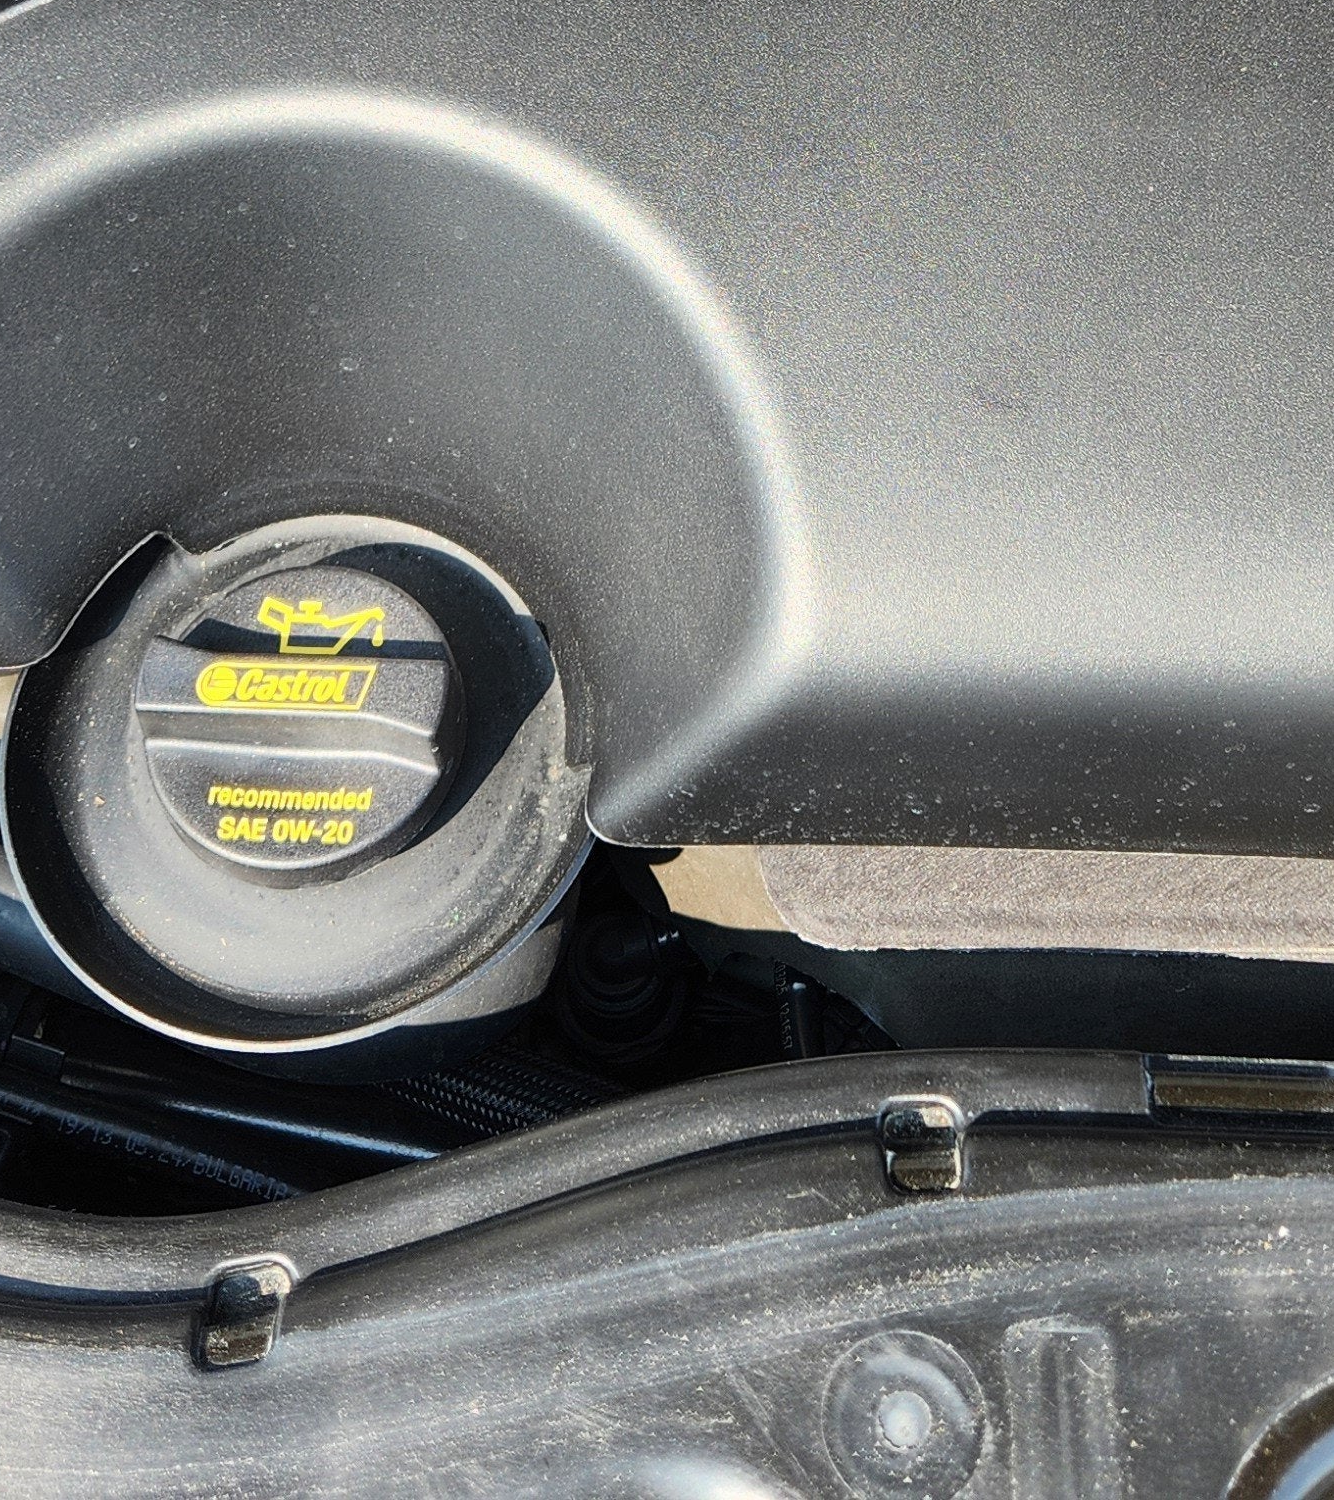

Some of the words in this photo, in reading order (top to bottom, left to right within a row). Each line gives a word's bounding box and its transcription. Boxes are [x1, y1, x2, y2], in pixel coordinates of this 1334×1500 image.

[235, 668, 350, 703] Castrol
[208, 785, 373, 812] recommended
[217, 816, 268, 842] SAE
[272, 819, 355, 845] 0W-20
